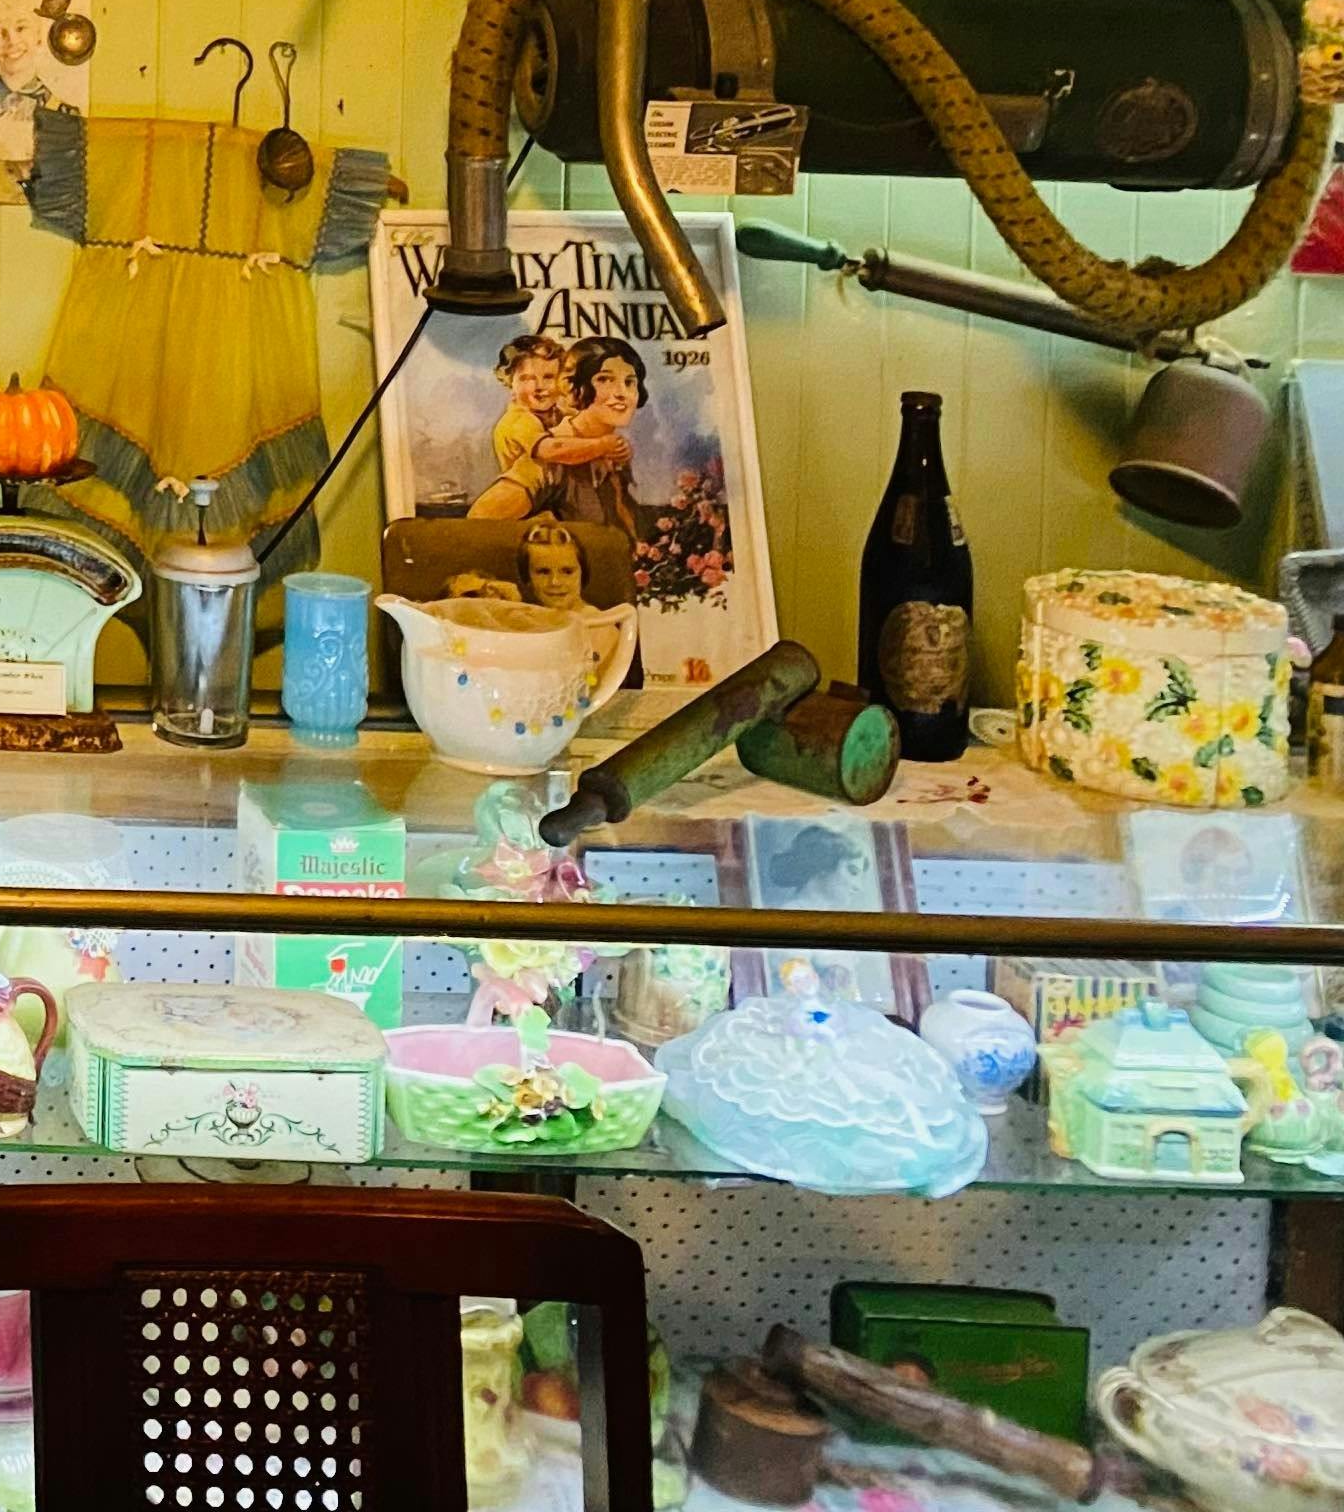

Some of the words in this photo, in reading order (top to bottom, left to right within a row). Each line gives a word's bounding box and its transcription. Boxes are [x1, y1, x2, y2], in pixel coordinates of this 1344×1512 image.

[529, 288, 709, 340] ANNUA
[661, 349, 711, 373] 1926
[299, 854, 388, 879] Majestic
